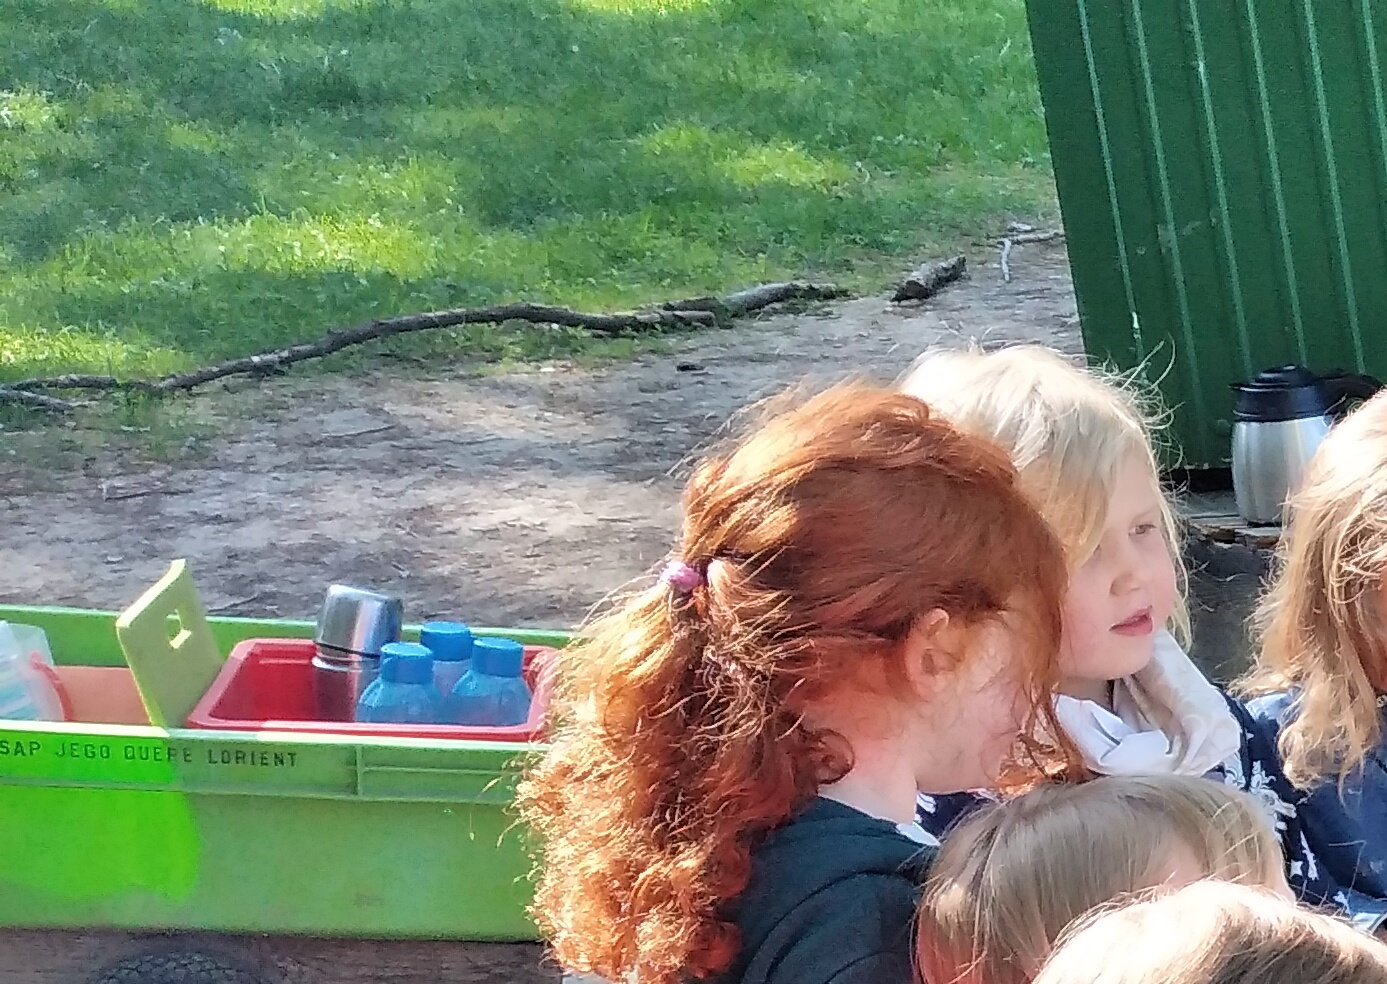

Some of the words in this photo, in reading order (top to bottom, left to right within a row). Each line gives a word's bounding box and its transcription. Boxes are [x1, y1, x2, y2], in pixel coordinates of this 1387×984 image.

[0, 740, 41, 757] SAP
[55, 742, 111, 759] JEGO
[208, 749, 298, 767] LORIENT
